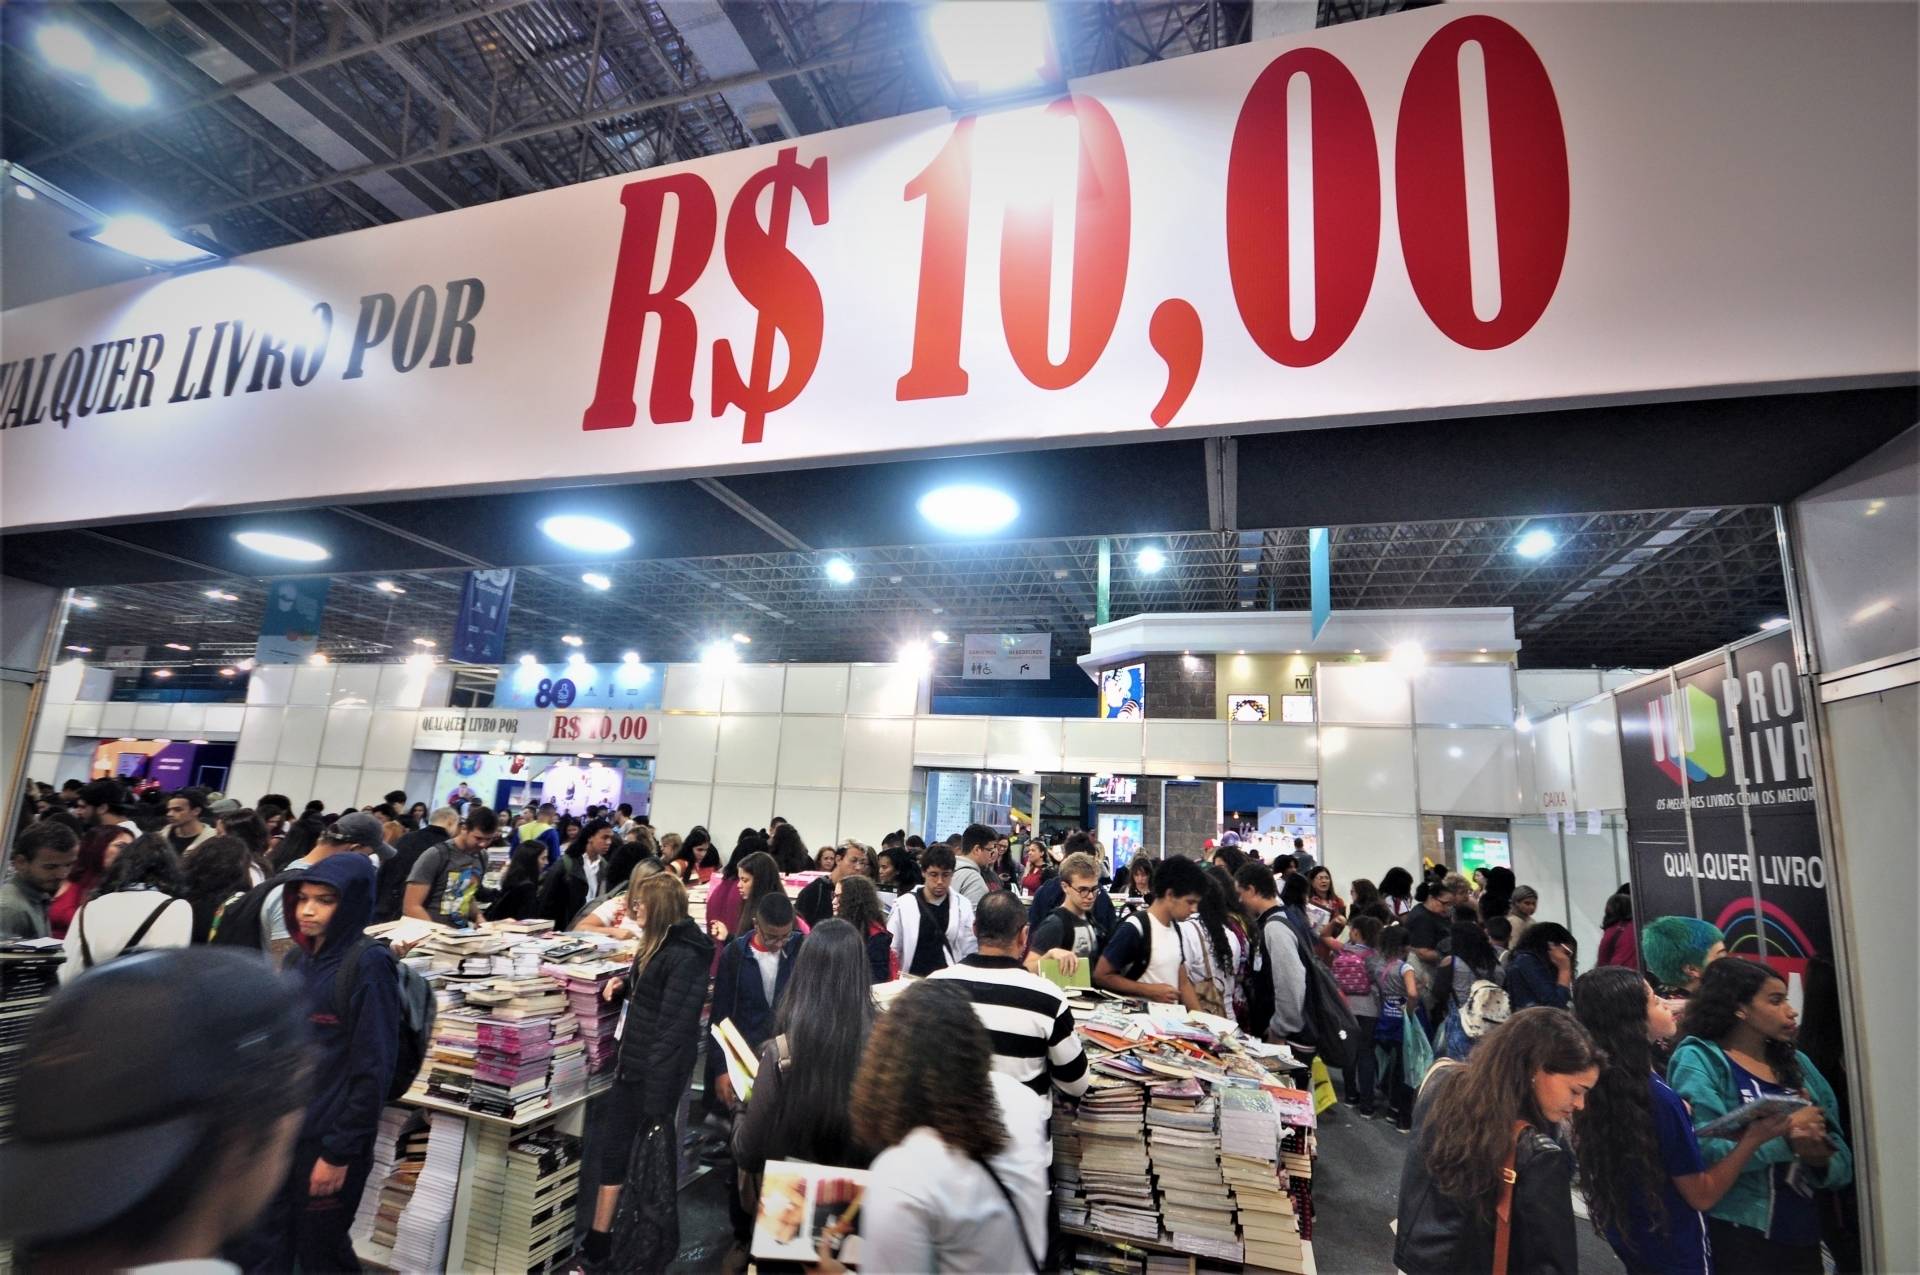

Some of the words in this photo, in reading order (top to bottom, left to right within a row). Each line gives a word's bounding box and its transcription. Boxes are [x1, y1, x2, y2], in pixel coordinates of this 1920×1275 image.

[168, 302, 333, 403] LIVRO
[342, 277, 486, 380] POR
[582, 147, 829, 444] R$
[895, 15, 1571, 428] 10,00
[1722, 662, 1794, 729] PRO
[498, 718, 519, 734] POR
[552, 715, 581, 740] R$
[1543, 792, 1568, 807] CAIXA
[1706, 793, 1735, 808] LIVROS
[1761, 789, 1775, 804] OS
[1663, 852, 1753, 882] QUALQUER
[1760, 855, 1827, 889] LIVRO
